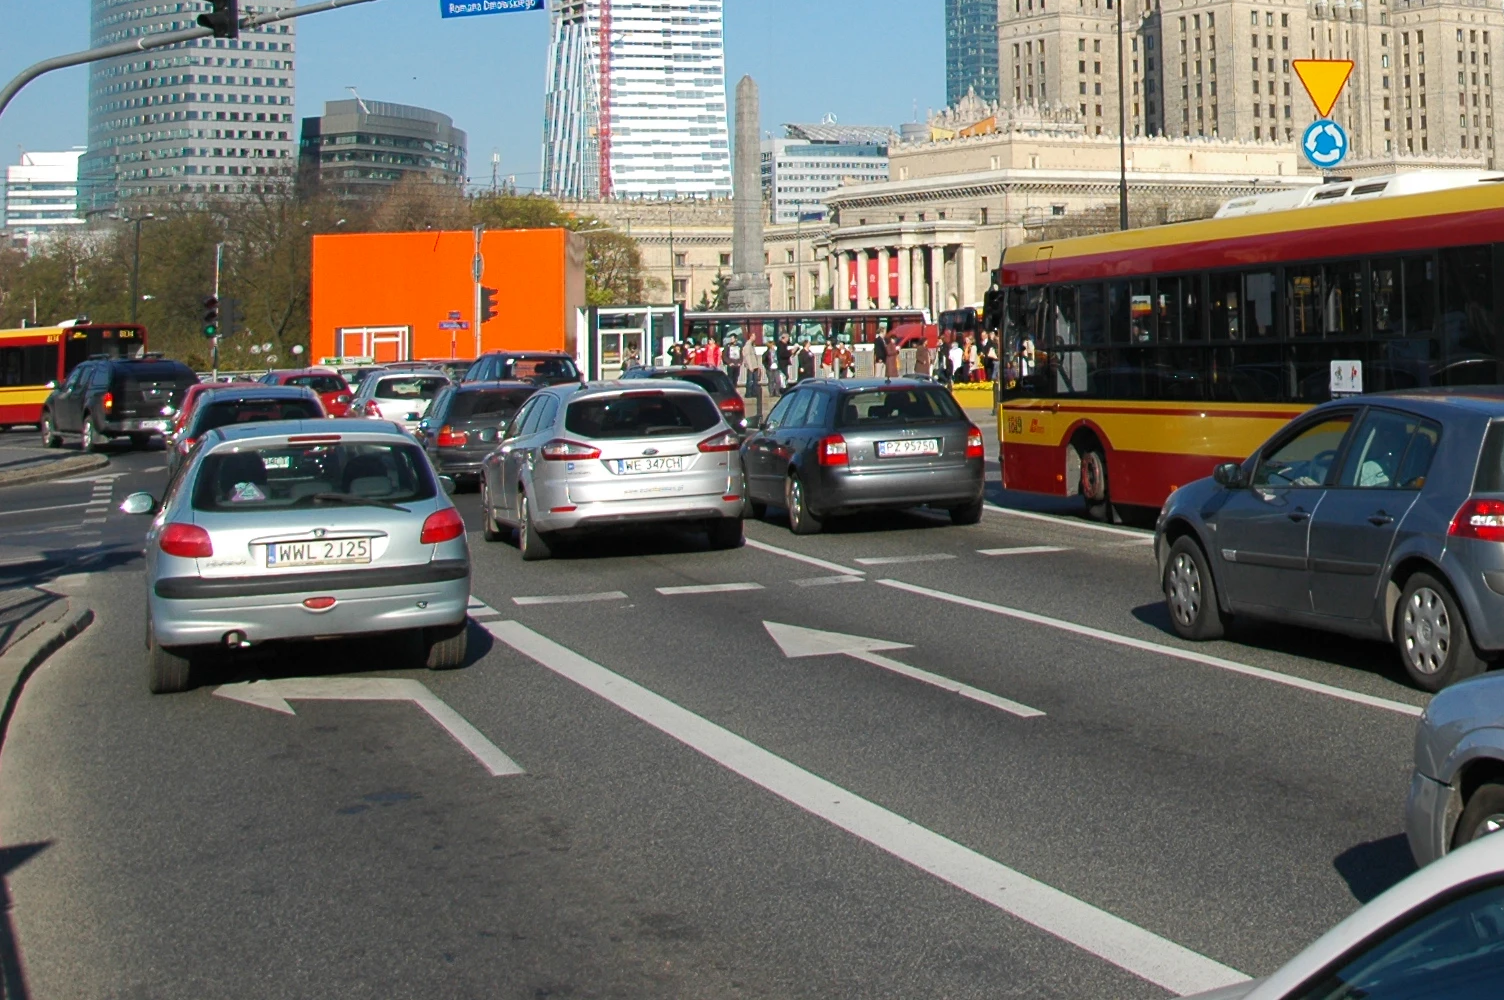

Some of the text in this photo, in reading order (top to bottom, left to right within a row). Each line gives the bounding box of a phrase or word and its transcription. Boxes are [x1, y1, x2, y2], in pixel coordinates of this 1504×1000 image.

[448, 2, 482, 14] Romana
[886, 440, 935, 452] PZ 95750
[625, 456, 681, 471] WE 347CH
[279, 544, 317, 562] WWL
[324, 540, 368, 559] 2J25
